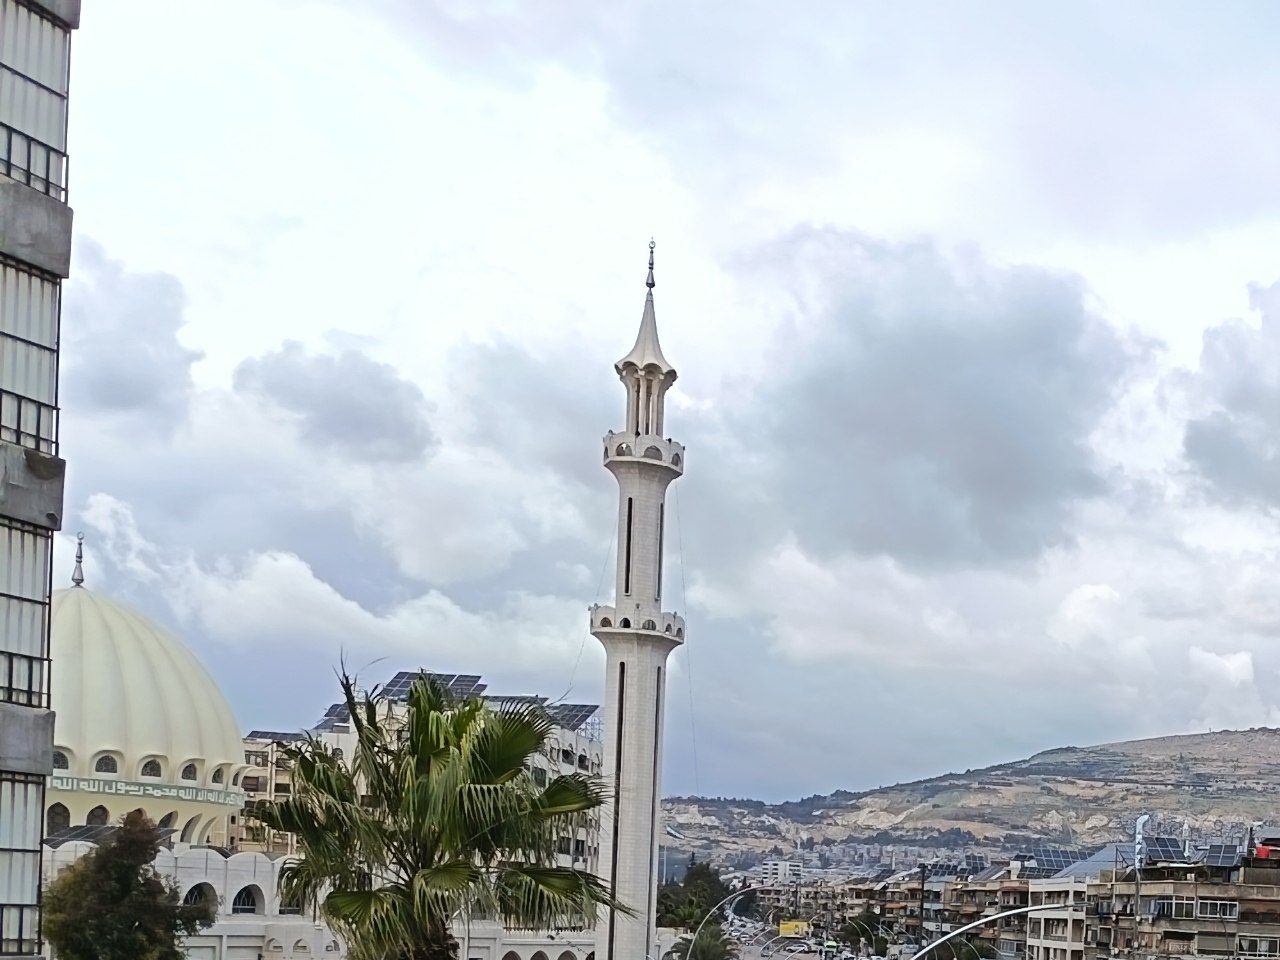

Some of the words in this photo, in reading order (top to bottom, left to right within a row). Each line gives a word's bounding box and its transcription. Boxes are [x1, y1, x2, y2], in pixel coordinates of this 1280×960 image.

[79, 779, 104, 792] الله
[105, 781, 144, 796] رسول
[145, 786, 178, 797] محمد
[178, 787, 196, 800] الله
